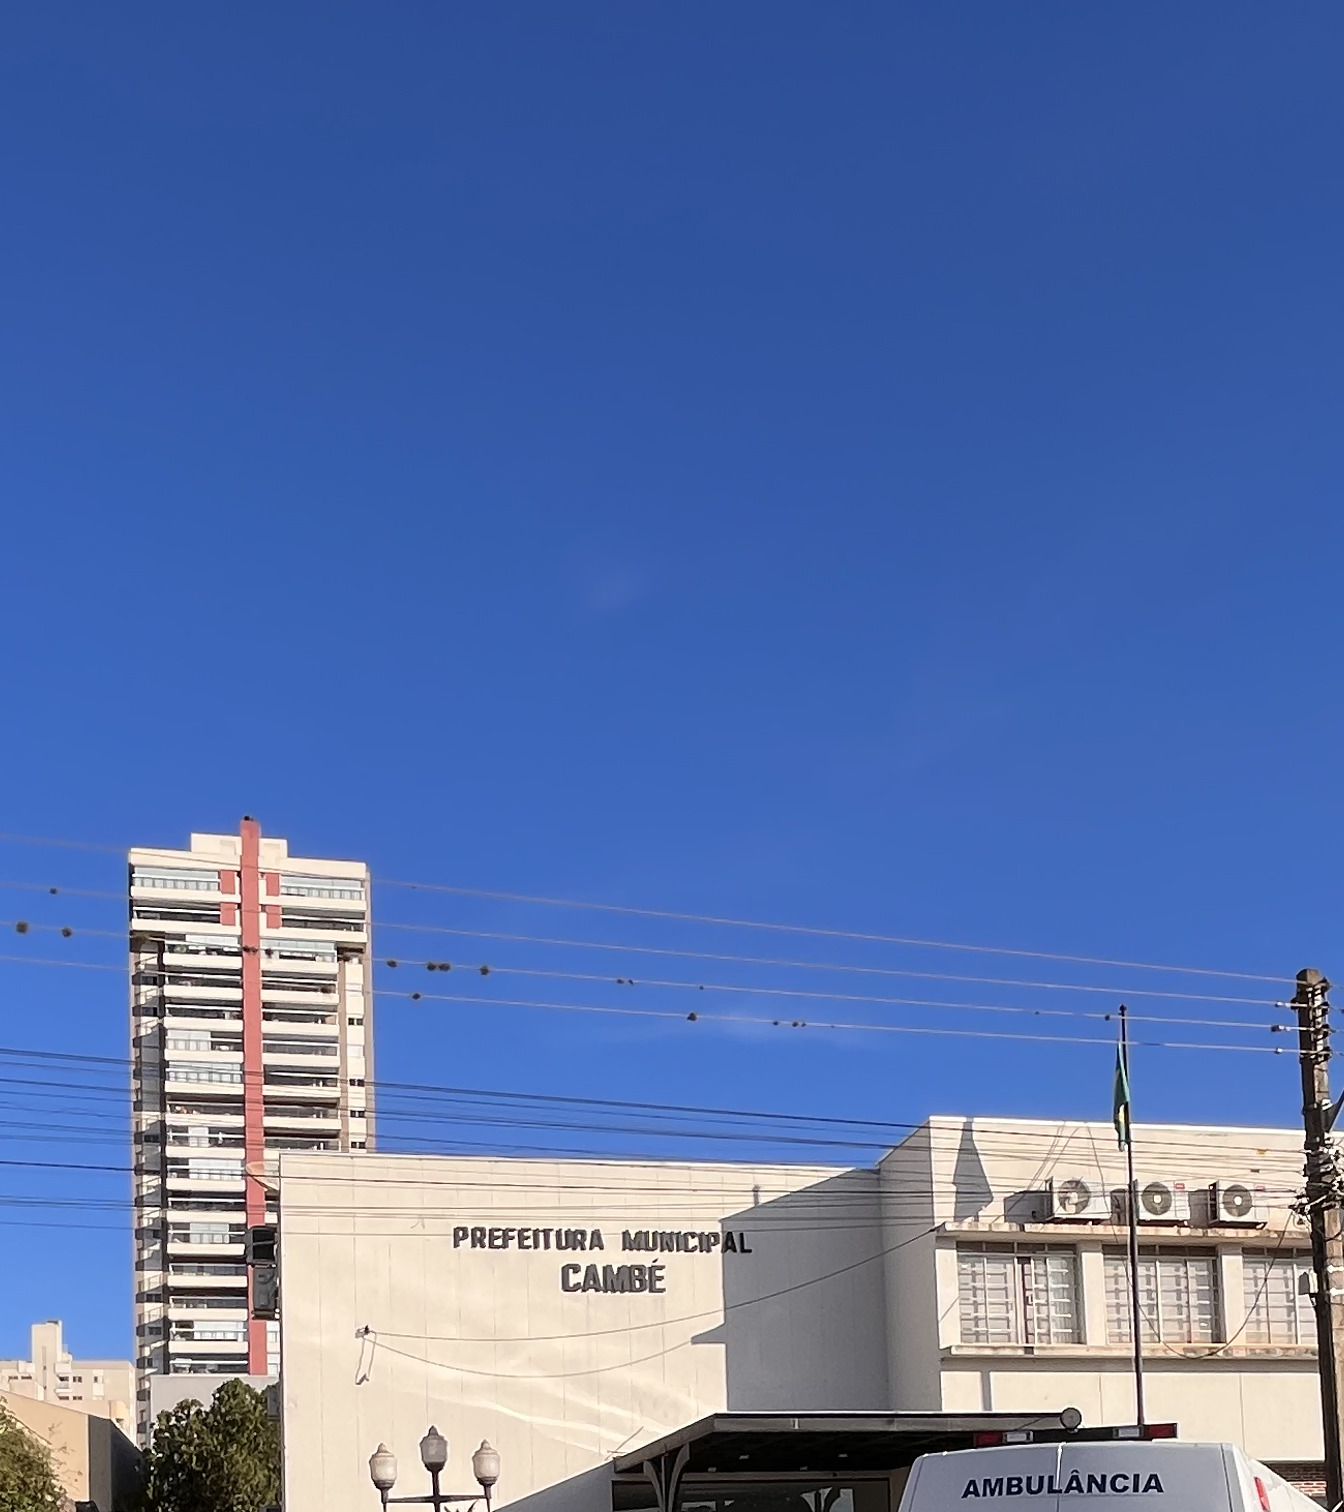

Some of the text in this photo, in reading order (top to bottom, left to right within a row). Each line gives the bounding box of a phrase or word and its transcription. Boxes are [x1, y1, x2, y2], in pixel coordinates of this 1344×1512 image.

[453, 1226, 752, 1253] PREFEITURA MUNICIPAL
[560, 1258, 666, 1293] CAMBÉ
[961, 1469, 1165, 1499] AMBULÂNCIA
